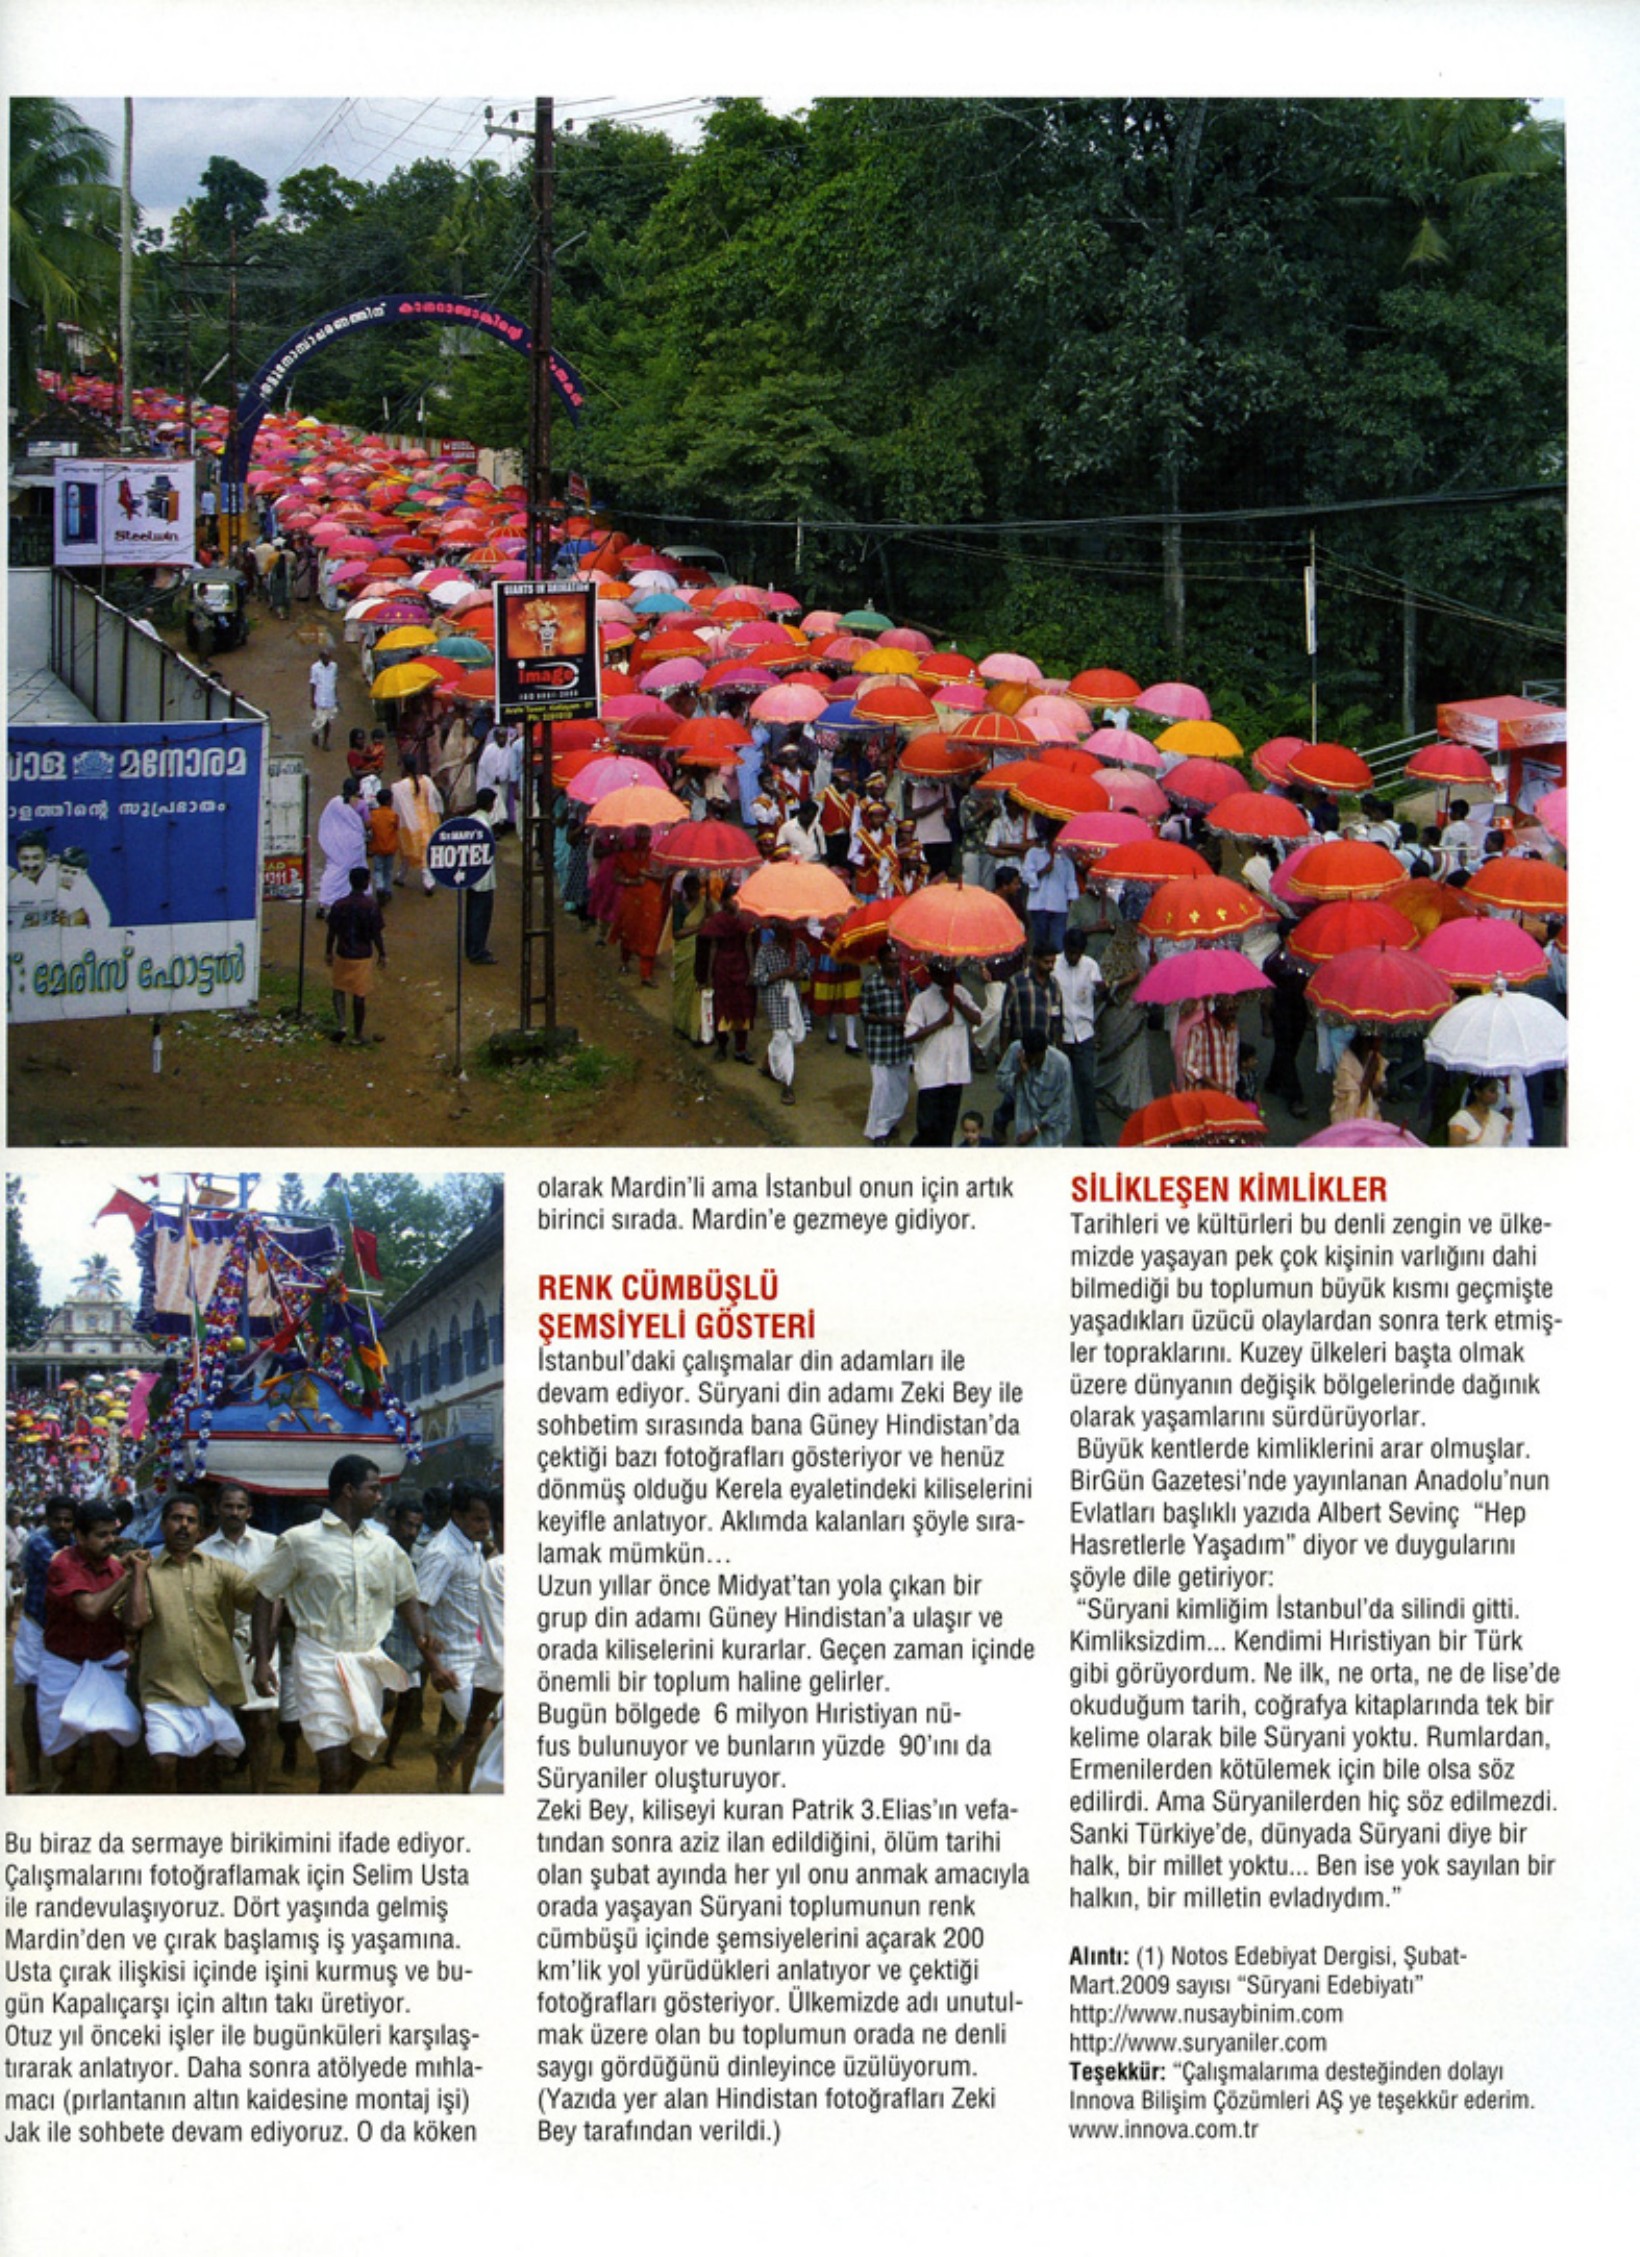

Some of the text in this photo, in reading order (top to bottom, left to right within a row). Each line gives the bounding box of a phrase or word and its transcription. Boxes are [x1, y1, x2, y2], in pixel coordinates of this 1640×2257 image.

[114, 530, 179, 542] Steelwin
[518, 660, 575, 686] image
[118, 747, 247, 779] മനോരമ
[430, 843, 494, 869] HOTEL
[537, 1176, 603, 1199] olarak
[711, 1180, 758, 1199] ama
[766, 1172, 852, 1199] İstanbul
[859, 1180, 913, 1199] onun
[921, 1175, 959, 1204] için
[965, 1176, 1014, 1199] artık
[1071, 1171, 1387, 1210] SİLİKLEŞEN KİMLİKLER
[1070, 1212, 1551, 1240] Tarihleri ve kültürleri bu denli zengin ve ülke-
[538, 1267, 779, 1308] RENK CÜMBÜŞLÜ
[538, 1307, 816, 1347] ŞEMSİYELİ GÖSTERİ
[682, 1349, 793, 1377] çalışmalar
[800, 1349, 833, 1372] din
[840, 1349, 934, 1372] adamları
[941, 1349, 965, 1372] ile
[1070, 1341, 1525, 1369] ler topraklarını. Kuzey ülkeleri başta olmak
[537, 1445, 1005, 1474] çektiği bazı fotoğrafları gösteriyor ve henüz
[1071, 1468, 1144, 1492] BirGün
[1293, 1469, 1407, 1497] yayınlanan
[538, 1574, 592, 1597] Uzun
[598, 1574, 652, 1601] yıllar
[659, 1574, 711, 1597] önce
[837, 1574, 882, 1601] yola
[889, 1574, 945, 1602] çıkan
[953, 1573, 982, 1597] bir
[1176, 1597, 1268, 1624] kimliğim
[1401, 1597, 1465, 1620] silindi
[1472, 1597, 1519, 1624] gitti.
[1070, 1724, 1550, 1753] kelime olarak bile Süryani yoktu. Rumlardan,
[5, 1831, 471, 1859] Bu biraz da sermaye birikimini ifade ediyor.
[536, 1830, 1001, 1858] tından sonra aziz ilan edildiğini, ölüm tarihi
[4, 1862, 469, 1892] Çalışmalarını fotoğraflamak için Selim Usta
[607, 1959, 640, 1986] yol
[647, 1958, 770, 1986] yürüdükleri
[776, 1959, 871, 1986] anlatıyor
[877, 1963, 902, 1981] ve
[909, 1958, 979, 1986] çektiği
[1068, 1945, 1467, 1971] Alıntı: (1) Notos Edebiyat Dergisi, Şubat-
[1069, 1974, 1170, 1995] Mart.2009
[1176, 1978, 1230, 1999] sayısı
[4, 1991, 411, 2020] gün Kapalıçarşı için altın takı üretiyor.
[1069, 2003, 1343, 2028] http://www.nusaybinim.com
[1069, 2032, 1327, 2057] http://www.suryaniler.com
[1068, 2060, 1166, 2087] Teşekkür:
[1325, 2061, 1441, 2086] desteğinden
[1447, 2061, 1503, 2085] dolayı
[538, 2086, 995, 2115] (Yazıda yer alan Hindistan fotoğrafları Zeki
[1070, 2089, 1535, 2115] Innova Bilişim Çözümleri AŞ ye teşekkür ederim.
[4, 2119, 477, 2147] Jak ile sohbete devam ediyoruz. O da köken
[1068, 2120, 1259, 2139] www.innova.com.tr
